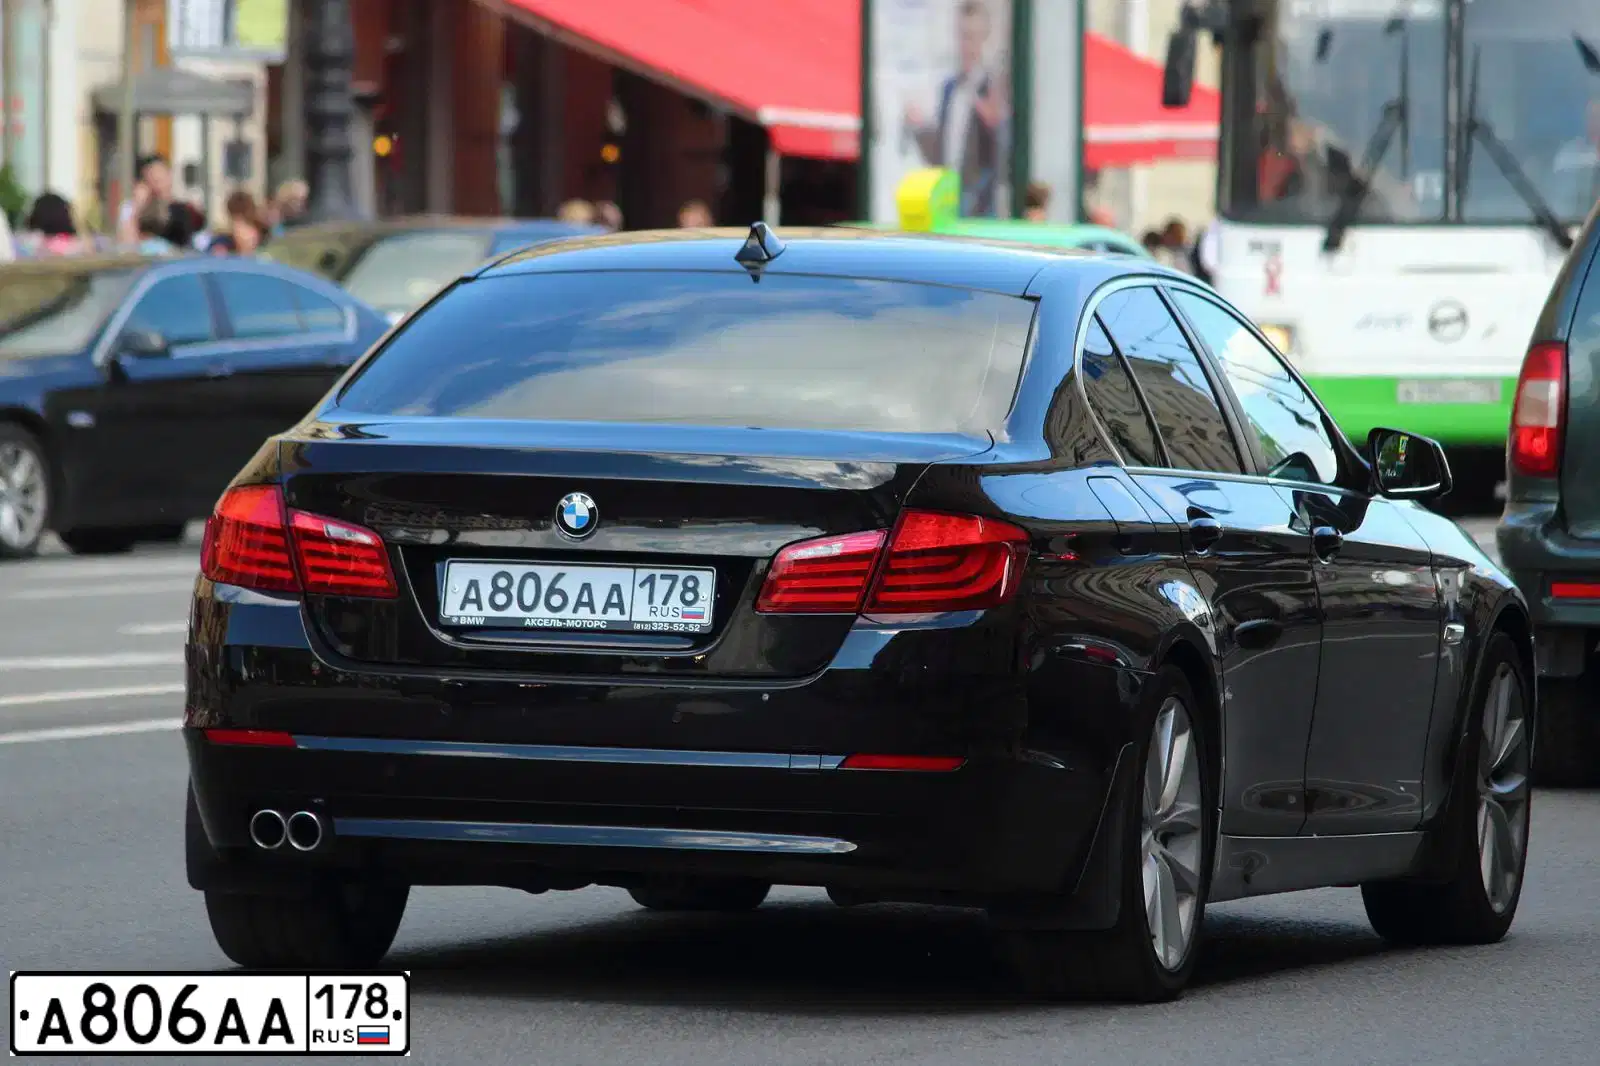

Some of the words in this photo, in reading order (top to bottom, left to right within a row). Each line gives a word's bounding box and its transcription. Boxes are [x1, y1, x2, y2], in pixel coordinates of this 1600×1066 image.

[638, 573, 700, 607] 178
[649, 606, 680, 618] RUS
[459, 616, 485, 625] BMW
[524, 618, 607, 629] АКСЕЛЬ-МОТОРС
